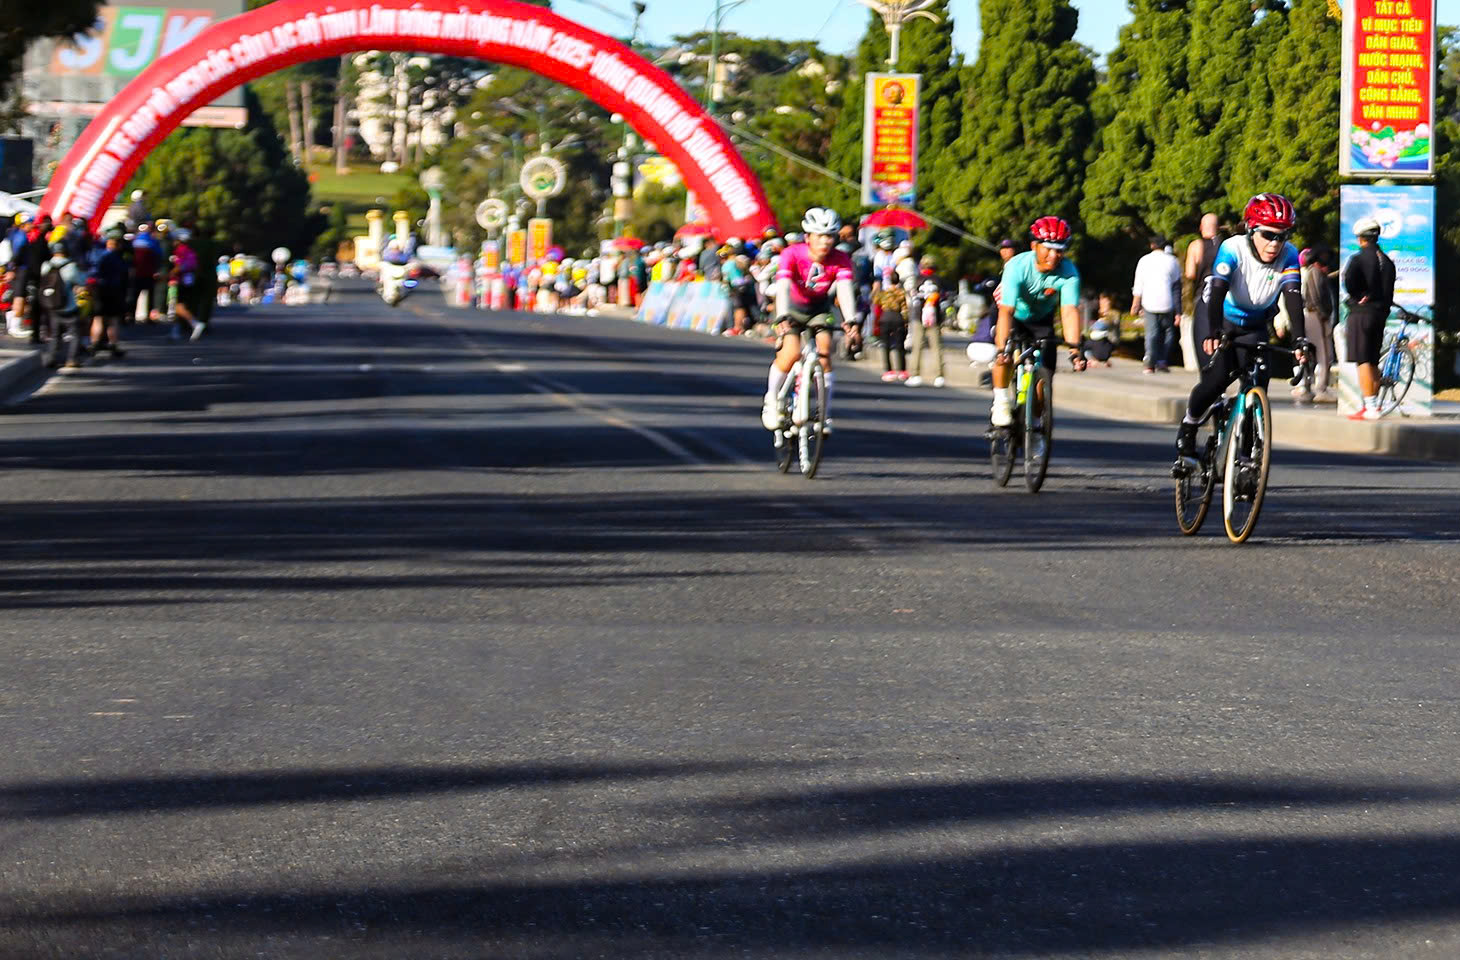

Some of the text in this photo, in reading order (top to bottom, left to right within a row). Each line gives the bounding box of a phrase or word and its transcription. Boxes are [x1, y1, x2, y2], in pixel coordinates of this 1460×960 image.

[1362, 16, 1423, 34] VÌ MỤC TIÊU
[1366, 34, 1388, 49] DÂN
[1367, 69, 1388, 84] DÂN
[1360, 85, 1388, 101] CÔNG
